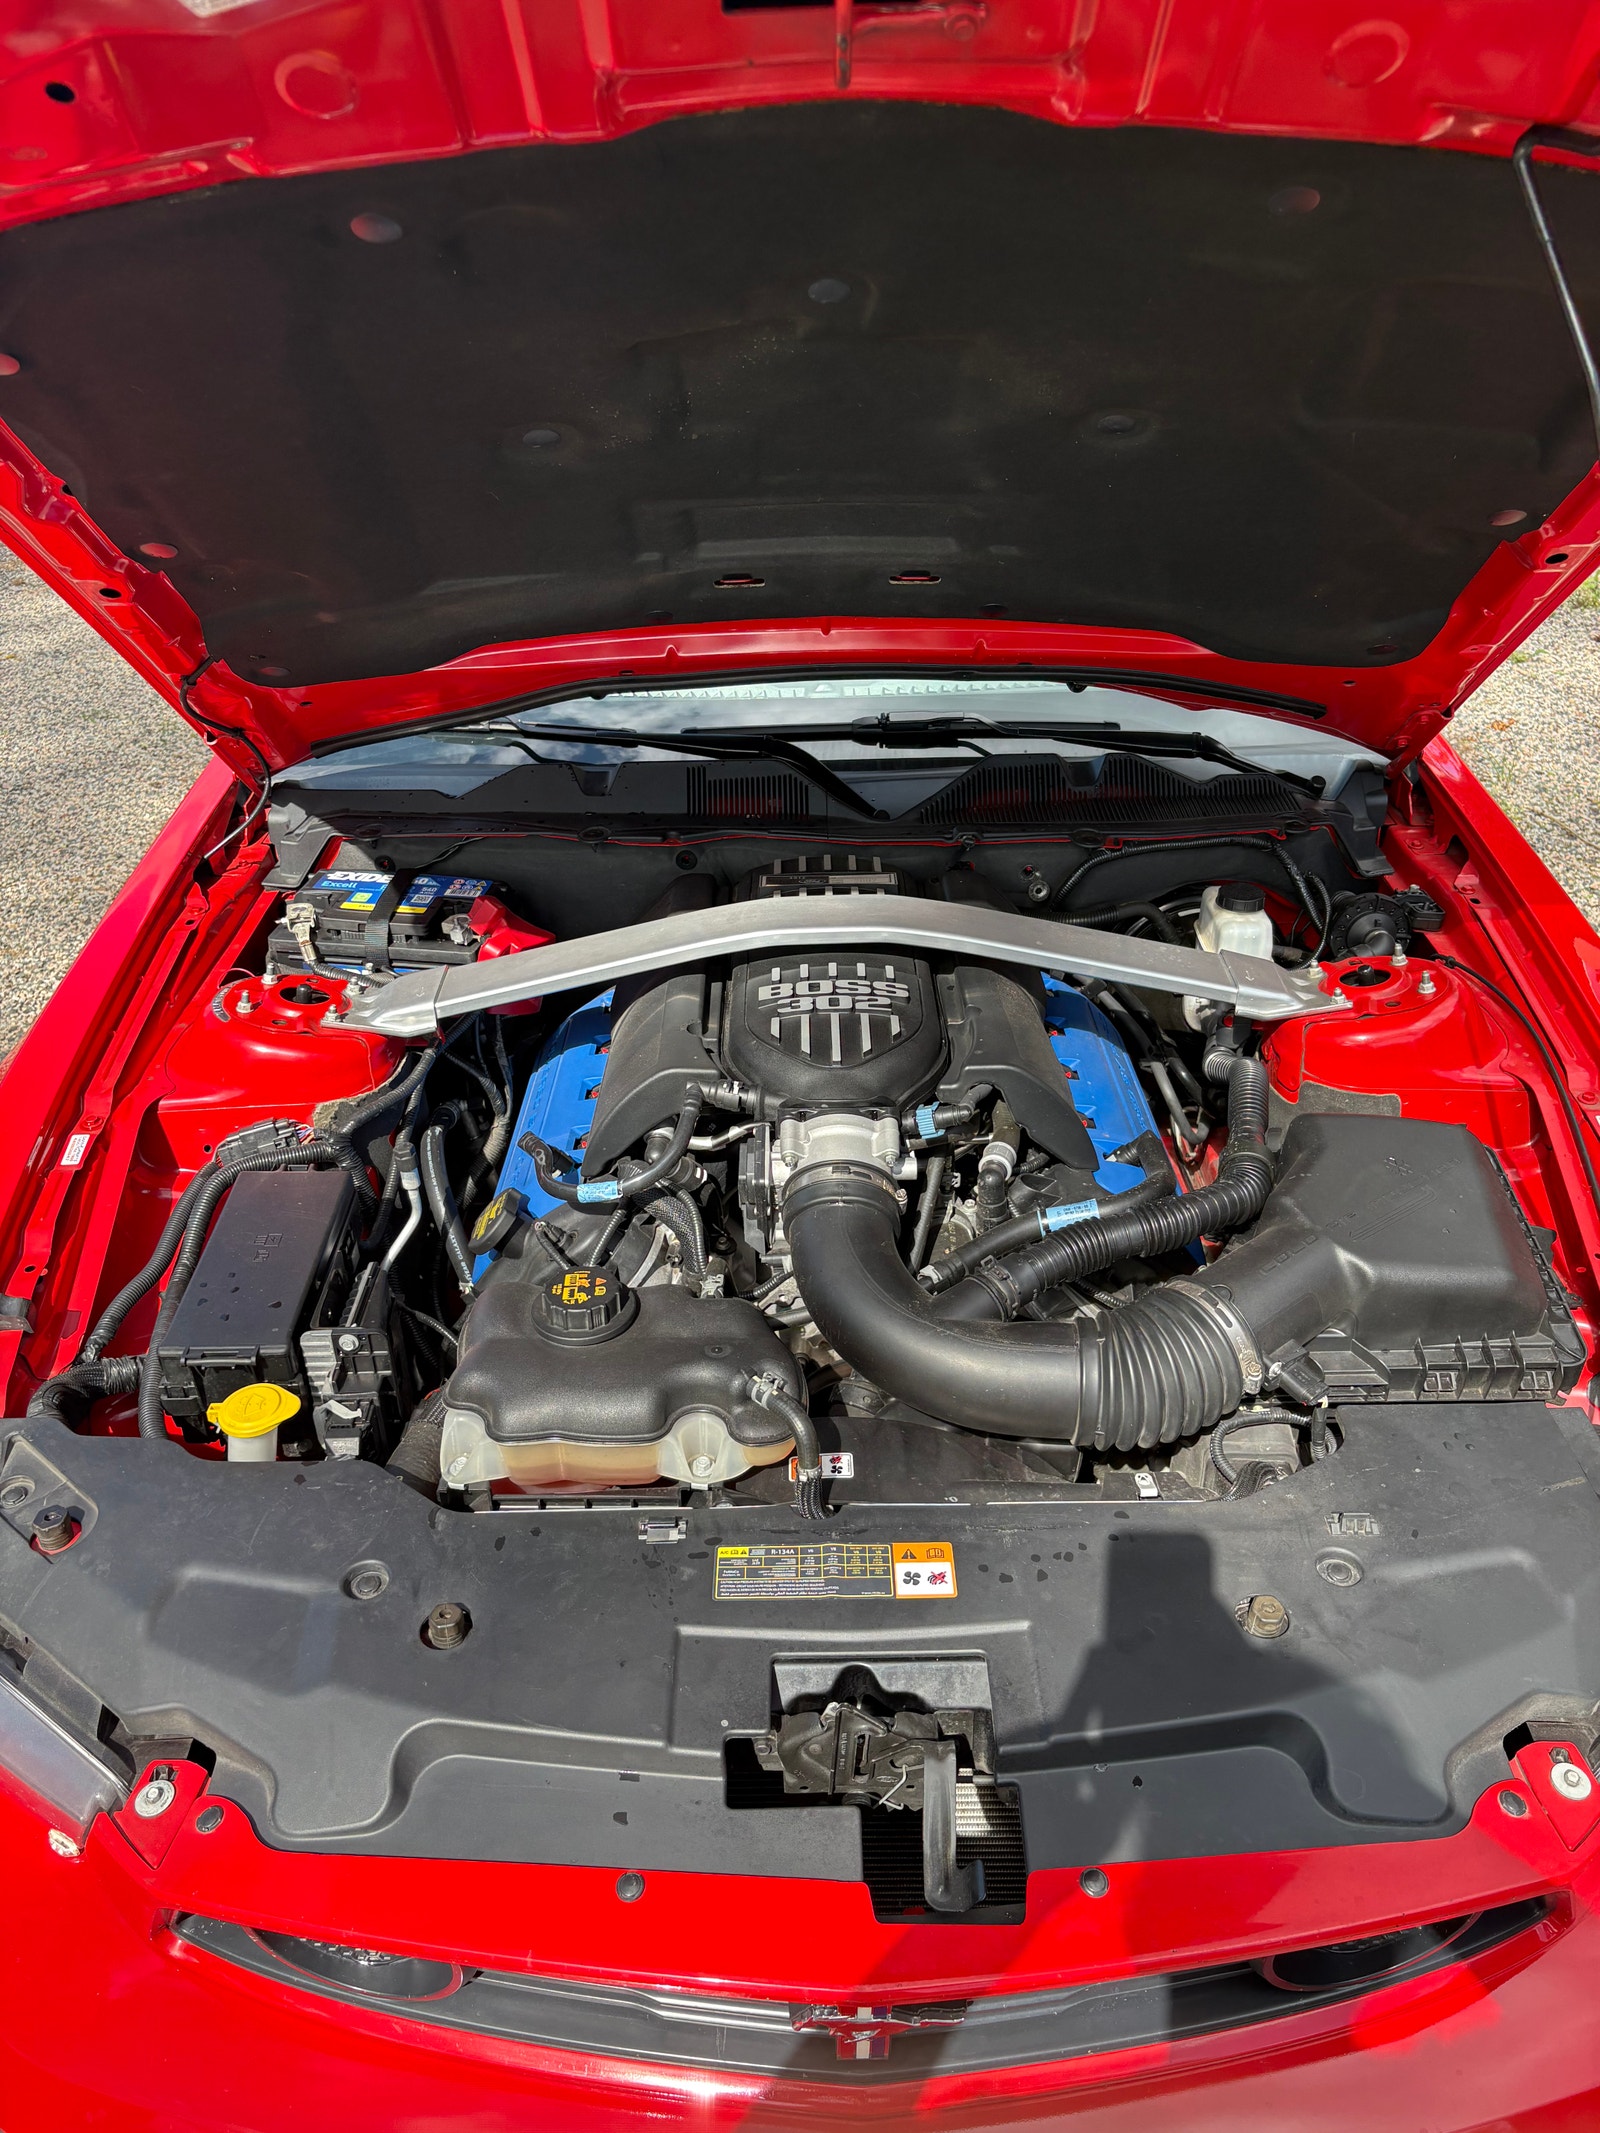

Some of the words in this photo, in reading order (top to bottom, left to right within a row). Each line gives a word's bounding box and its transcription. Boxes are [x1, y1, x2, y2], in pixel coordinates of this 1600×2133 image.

[321, 880, 358, 889] Excell
[327, 871, 395, 883] EXIDE
[758, 979, 909, 1001] BOSS
[777, 995, 892, 1013] 302
[449, 1234, 463, 1260] GALAXY
